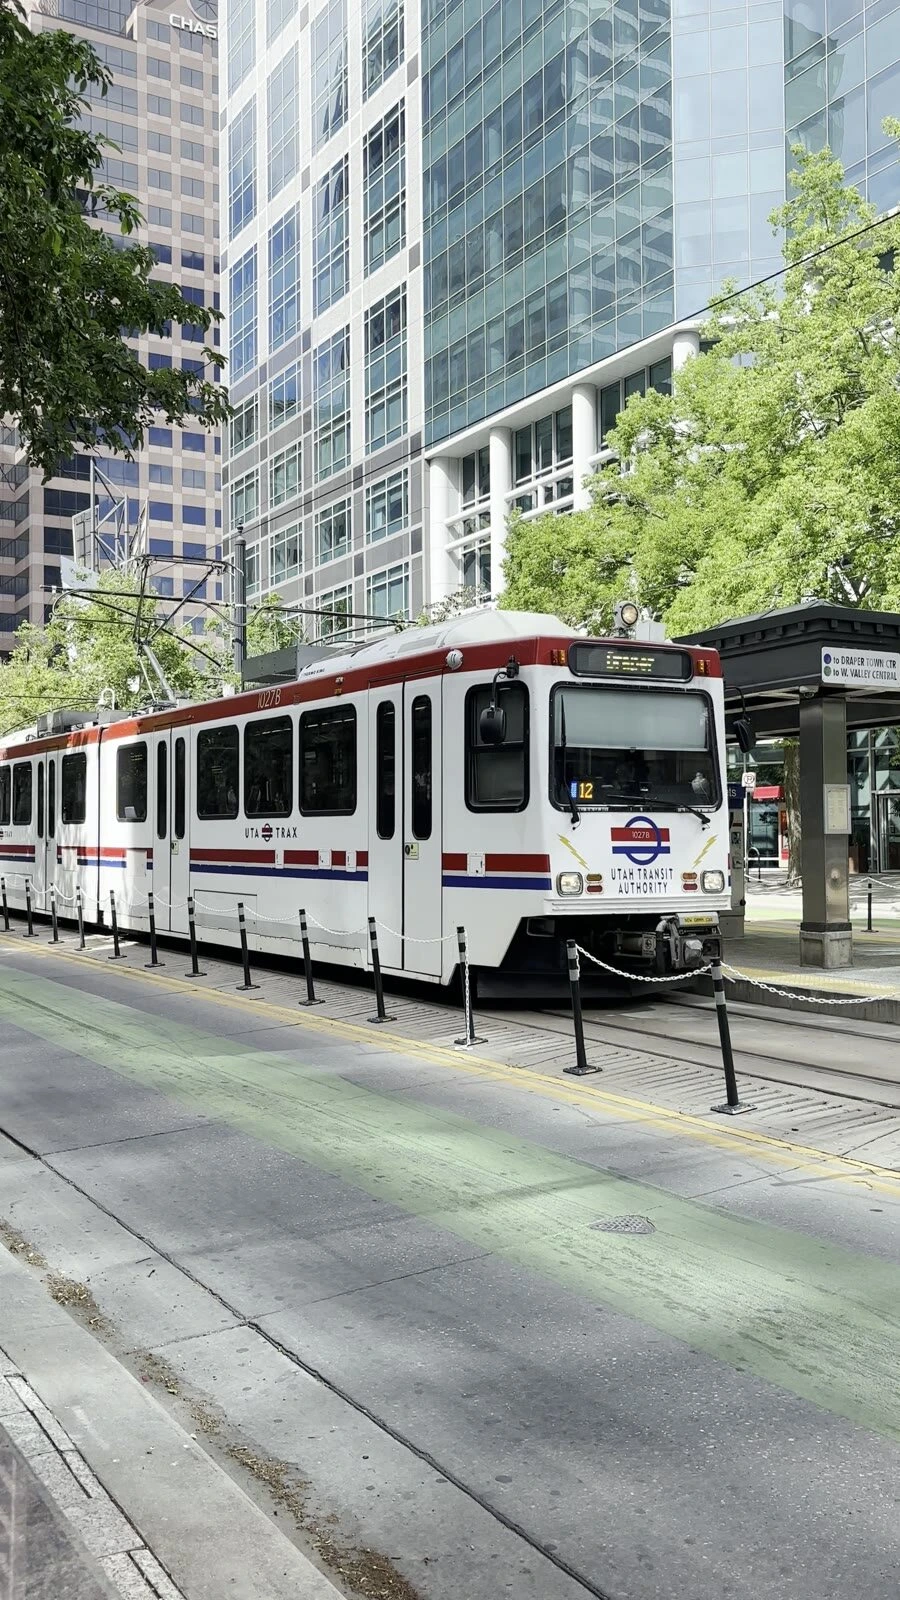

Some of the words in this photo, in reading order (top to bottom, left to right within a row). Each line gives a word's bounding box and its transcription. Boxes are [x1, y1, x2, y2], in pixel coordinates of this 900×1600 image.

[833, 656, 840, 665] to
[841, 656, 865, 667] DRAPER
[866, 658, 885, 669] TOWN
[886, 660, 897, 669] CTR
[833, 669, 840, 677] to
[850, 669, 871, 679] VALLEY
[872, 671, 897, 681] CENTRAL
[258, 689, 282, 709] 1027B
[580, 782, 593, 799] 12
[245, 828, 260, 839] UTA
[276, 827, 298, 839] TRAX
[632, 831, 650, 839] 1027B
[611, 868, 634, 880] UTAH
[638, 868, 673, 880] TRANSIT
[619, 882, 668, 895] AUTHORITY
